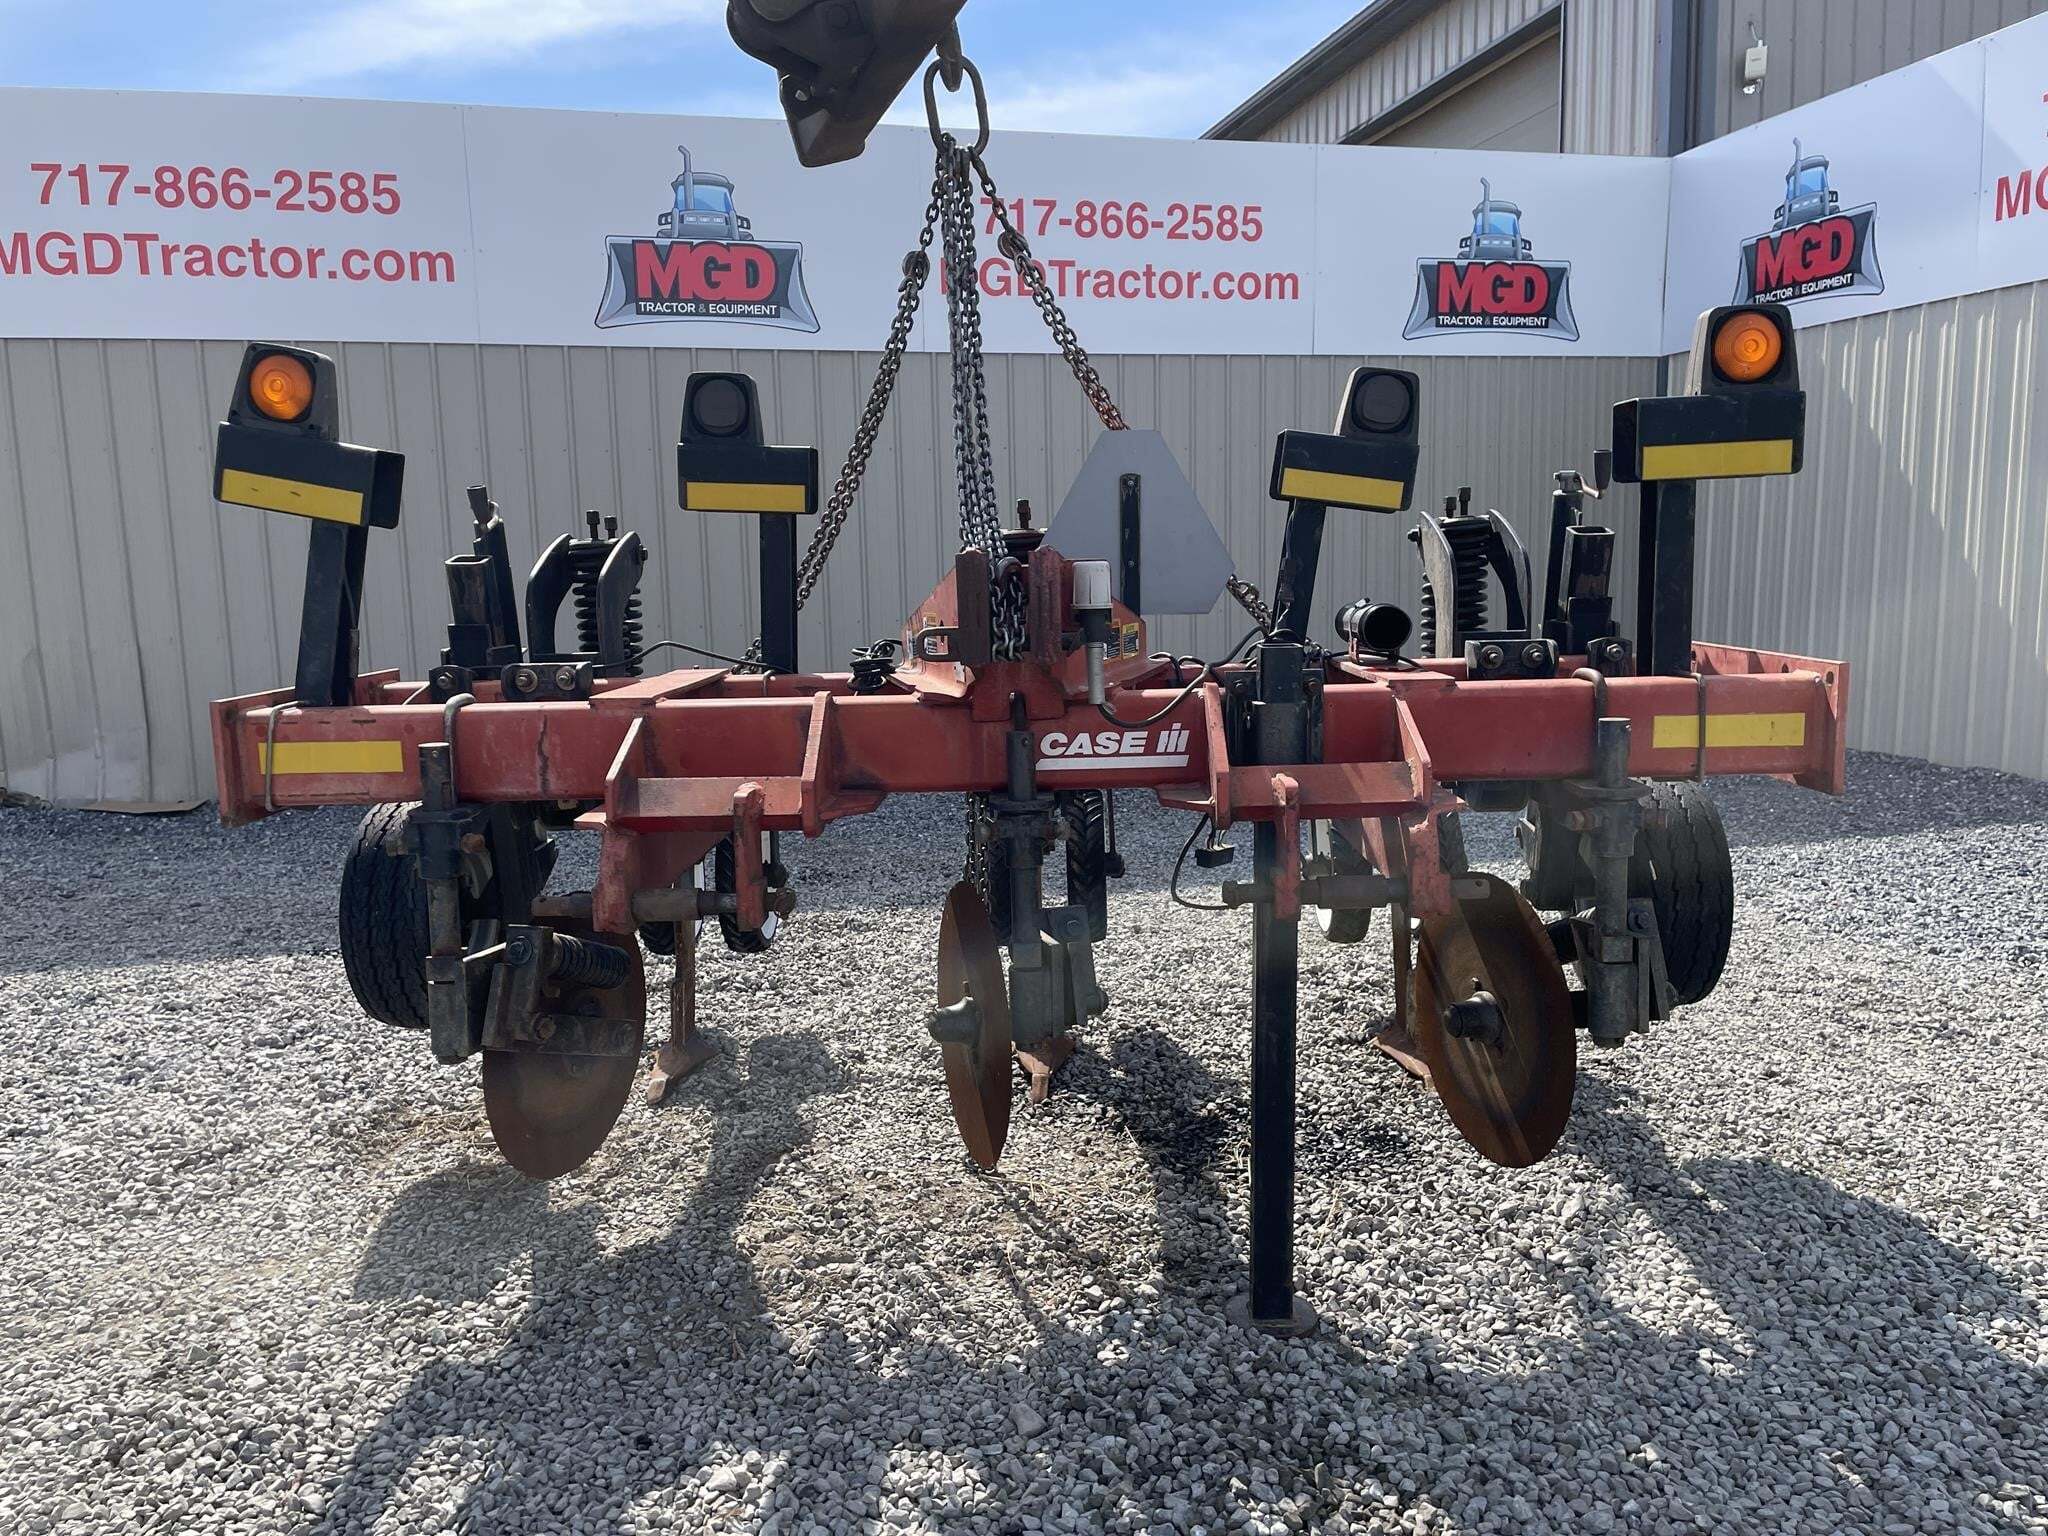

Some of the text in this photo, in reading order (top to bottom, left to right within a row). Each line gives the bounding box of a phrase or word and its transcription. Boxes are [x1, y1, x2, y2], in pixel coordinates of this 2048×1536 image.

[30, 162, 401, 215] 717-866-2585
[980, 197, 1263, 242] 717-866-2585
[0, 231, 455, 282] MGDTractor.com
[635, 242, 776, 301] MGD
[1755, 217, 1854, 292] MGD
[940, 257, 1300, 300] GDTractor.com
[1437, 262, 1548, 315] MGD
[1755, 287, 1793, 304] TRACTOR
[1801, 273, 1853, 294] EQUIPMENT
[638, 301, 777, 315] TRACTOR & EQUIPMENT
[1438, 315, 1483, 326] TRACTOR
[1492, 316, 1548, 327] EQUIPMENT
[1039, 731, 1148, 756] CASE
